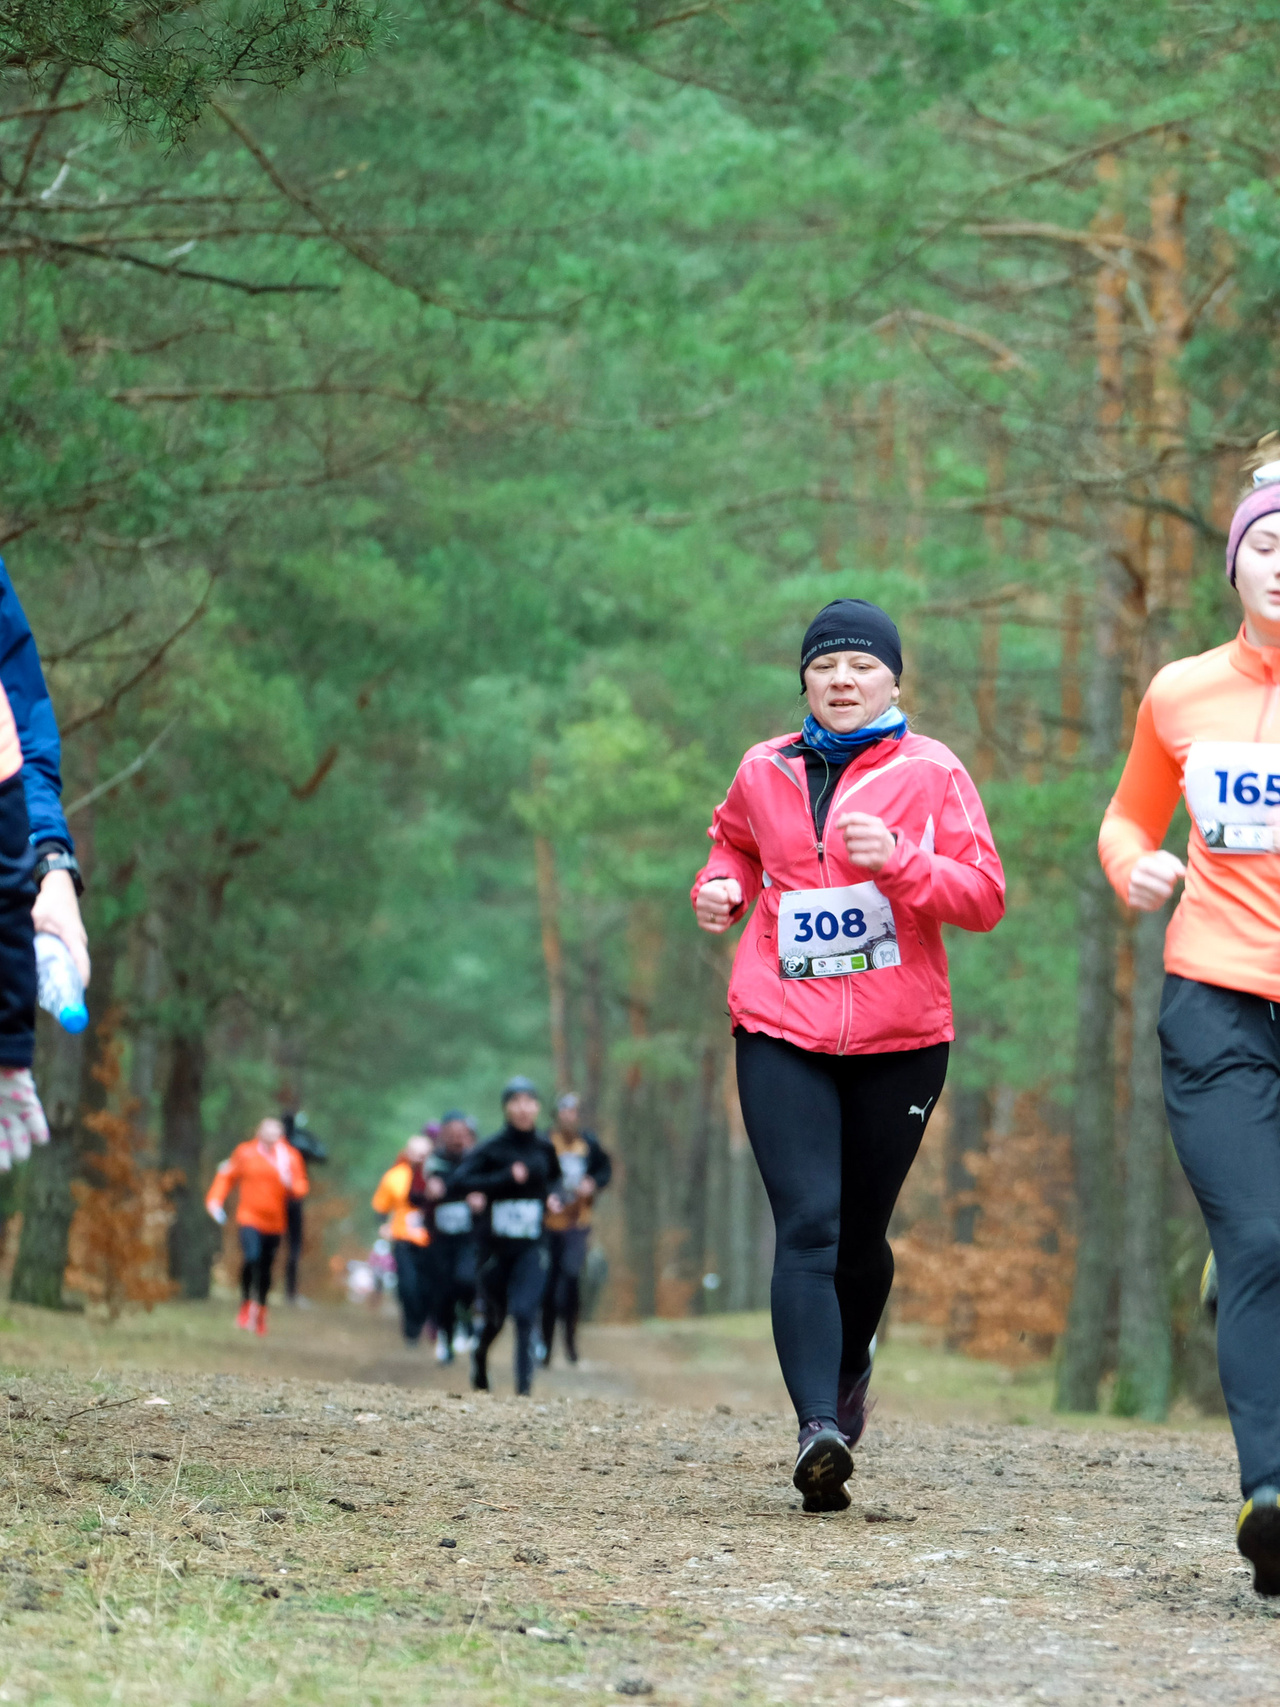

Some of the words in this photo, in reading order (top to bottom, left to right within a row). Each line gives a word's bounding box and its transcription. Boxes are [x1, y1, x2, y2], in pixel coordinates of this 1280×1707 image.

[818, 638, 845, 649] YOUR
[847, 637, 872, 647] WAY
[794, 908, 867, 942] 308
